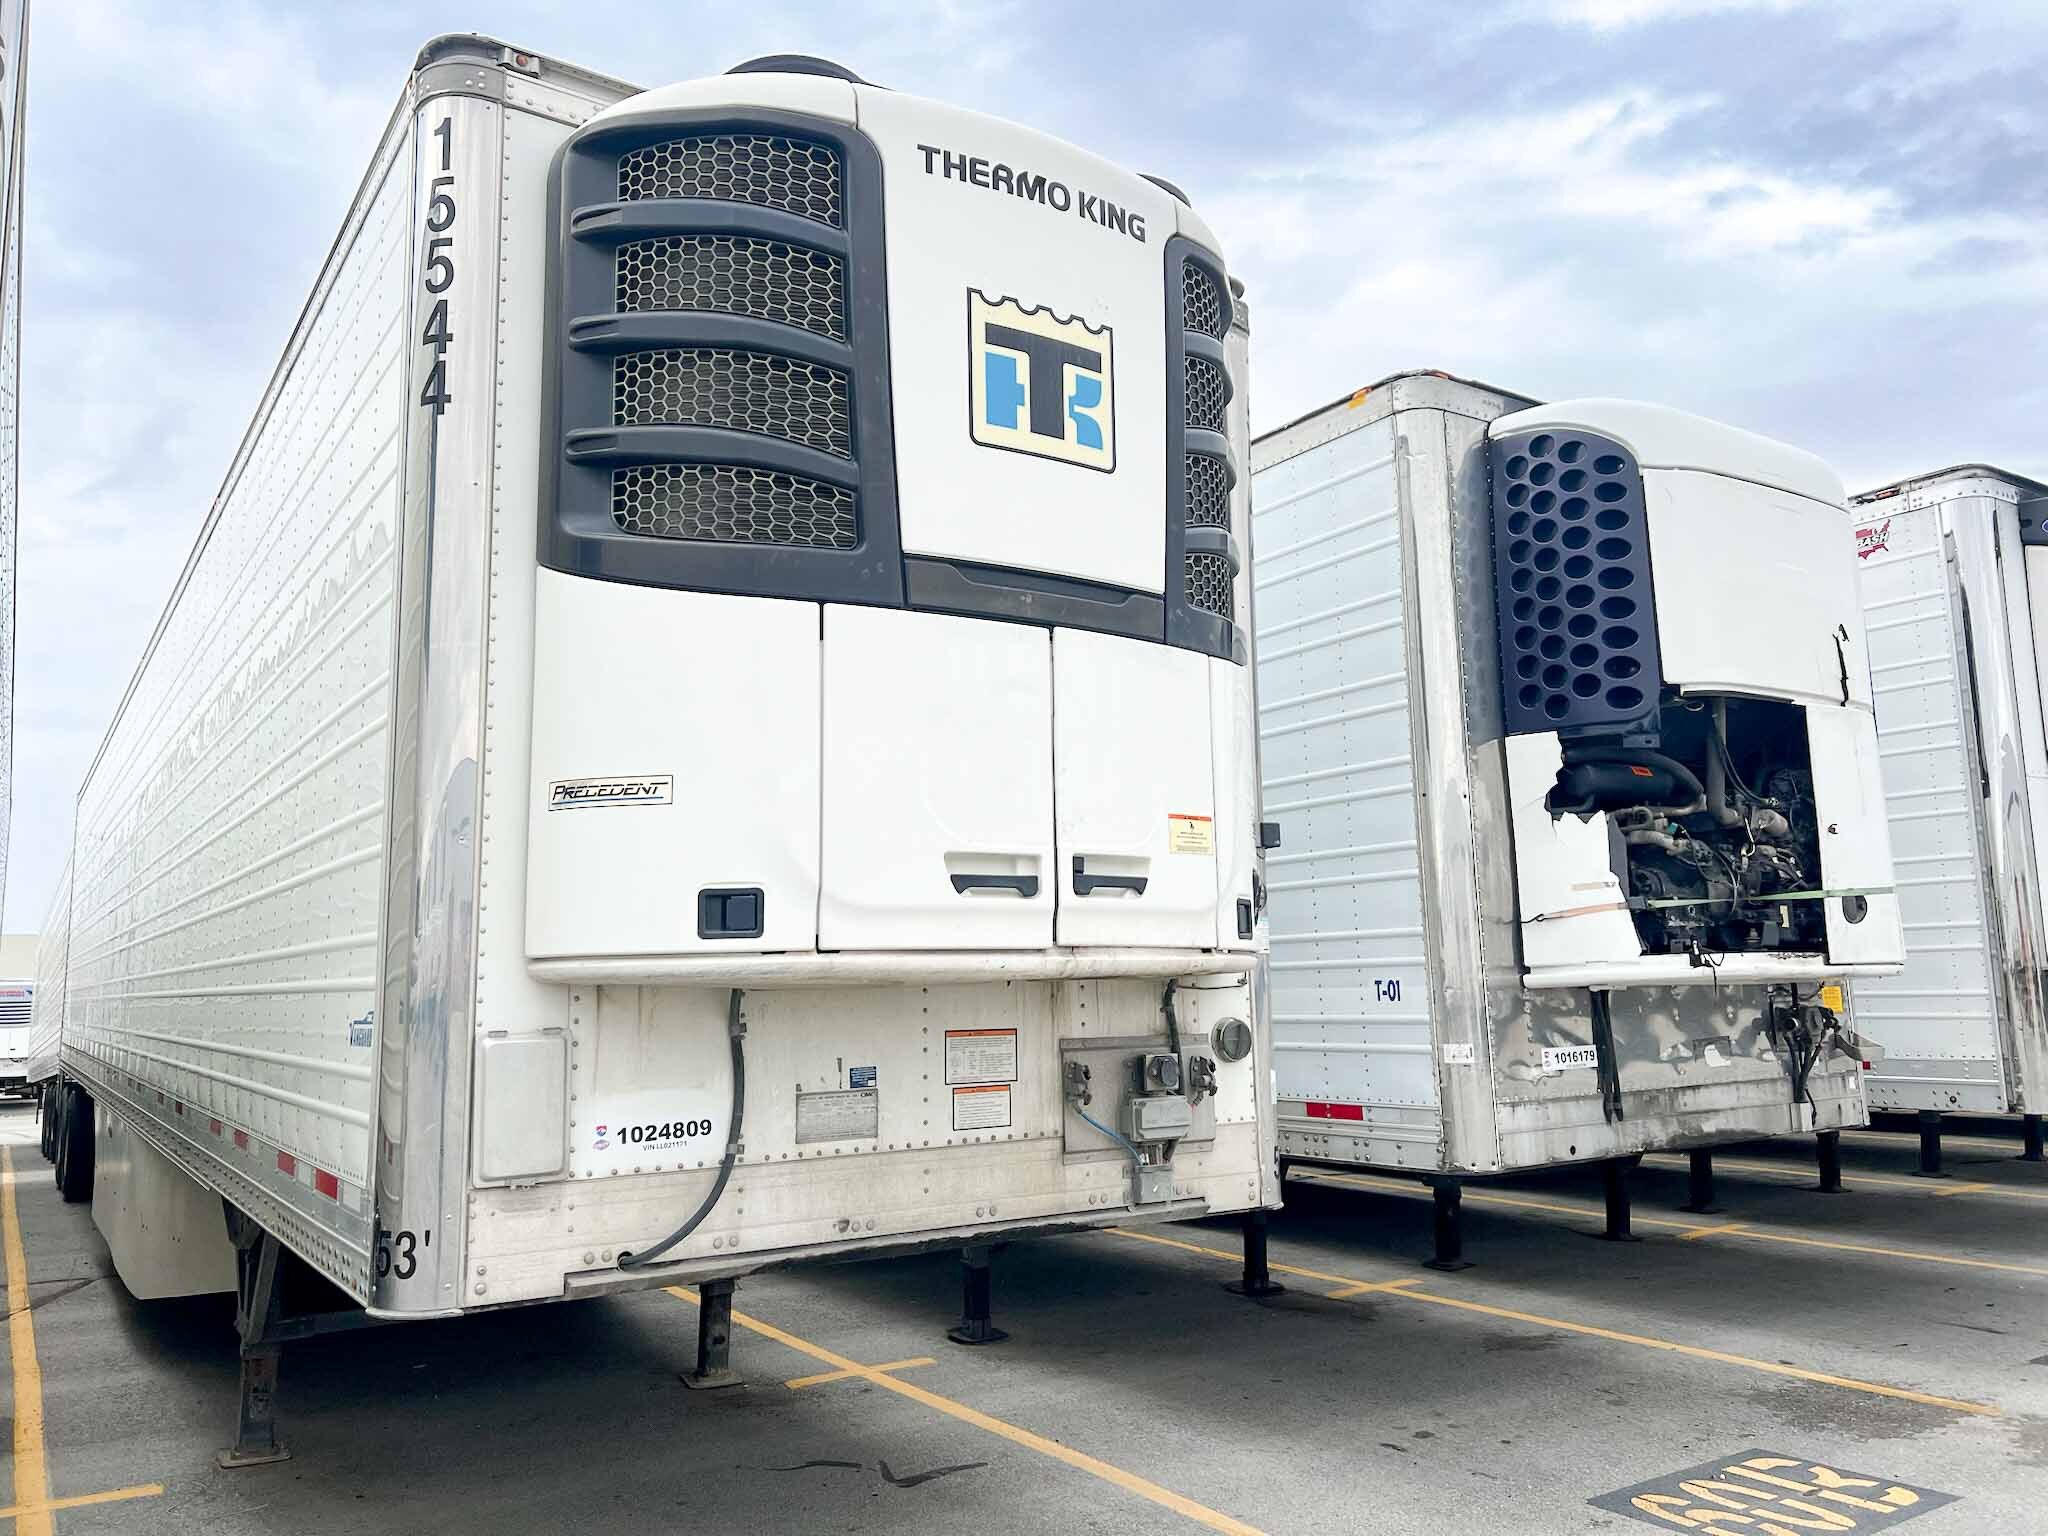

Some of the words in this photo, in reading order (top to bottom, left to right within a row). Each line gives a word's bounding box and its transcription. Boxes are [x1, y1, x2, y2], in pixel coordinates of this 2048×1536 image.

[916, 143, 1072, 213] THERMO
[1077, 189, 1146, 244] KING
[420, 116, 456, 416] 15544
[1374, 979, 1401, 1002] T-01
[1554, 1050, 1595, 1064] 1016179
[617, 1119, 713, 1145] 1024809
[642, 1144, 656, 1152] VIN
[376, 1229, 431, 1280] 53'
